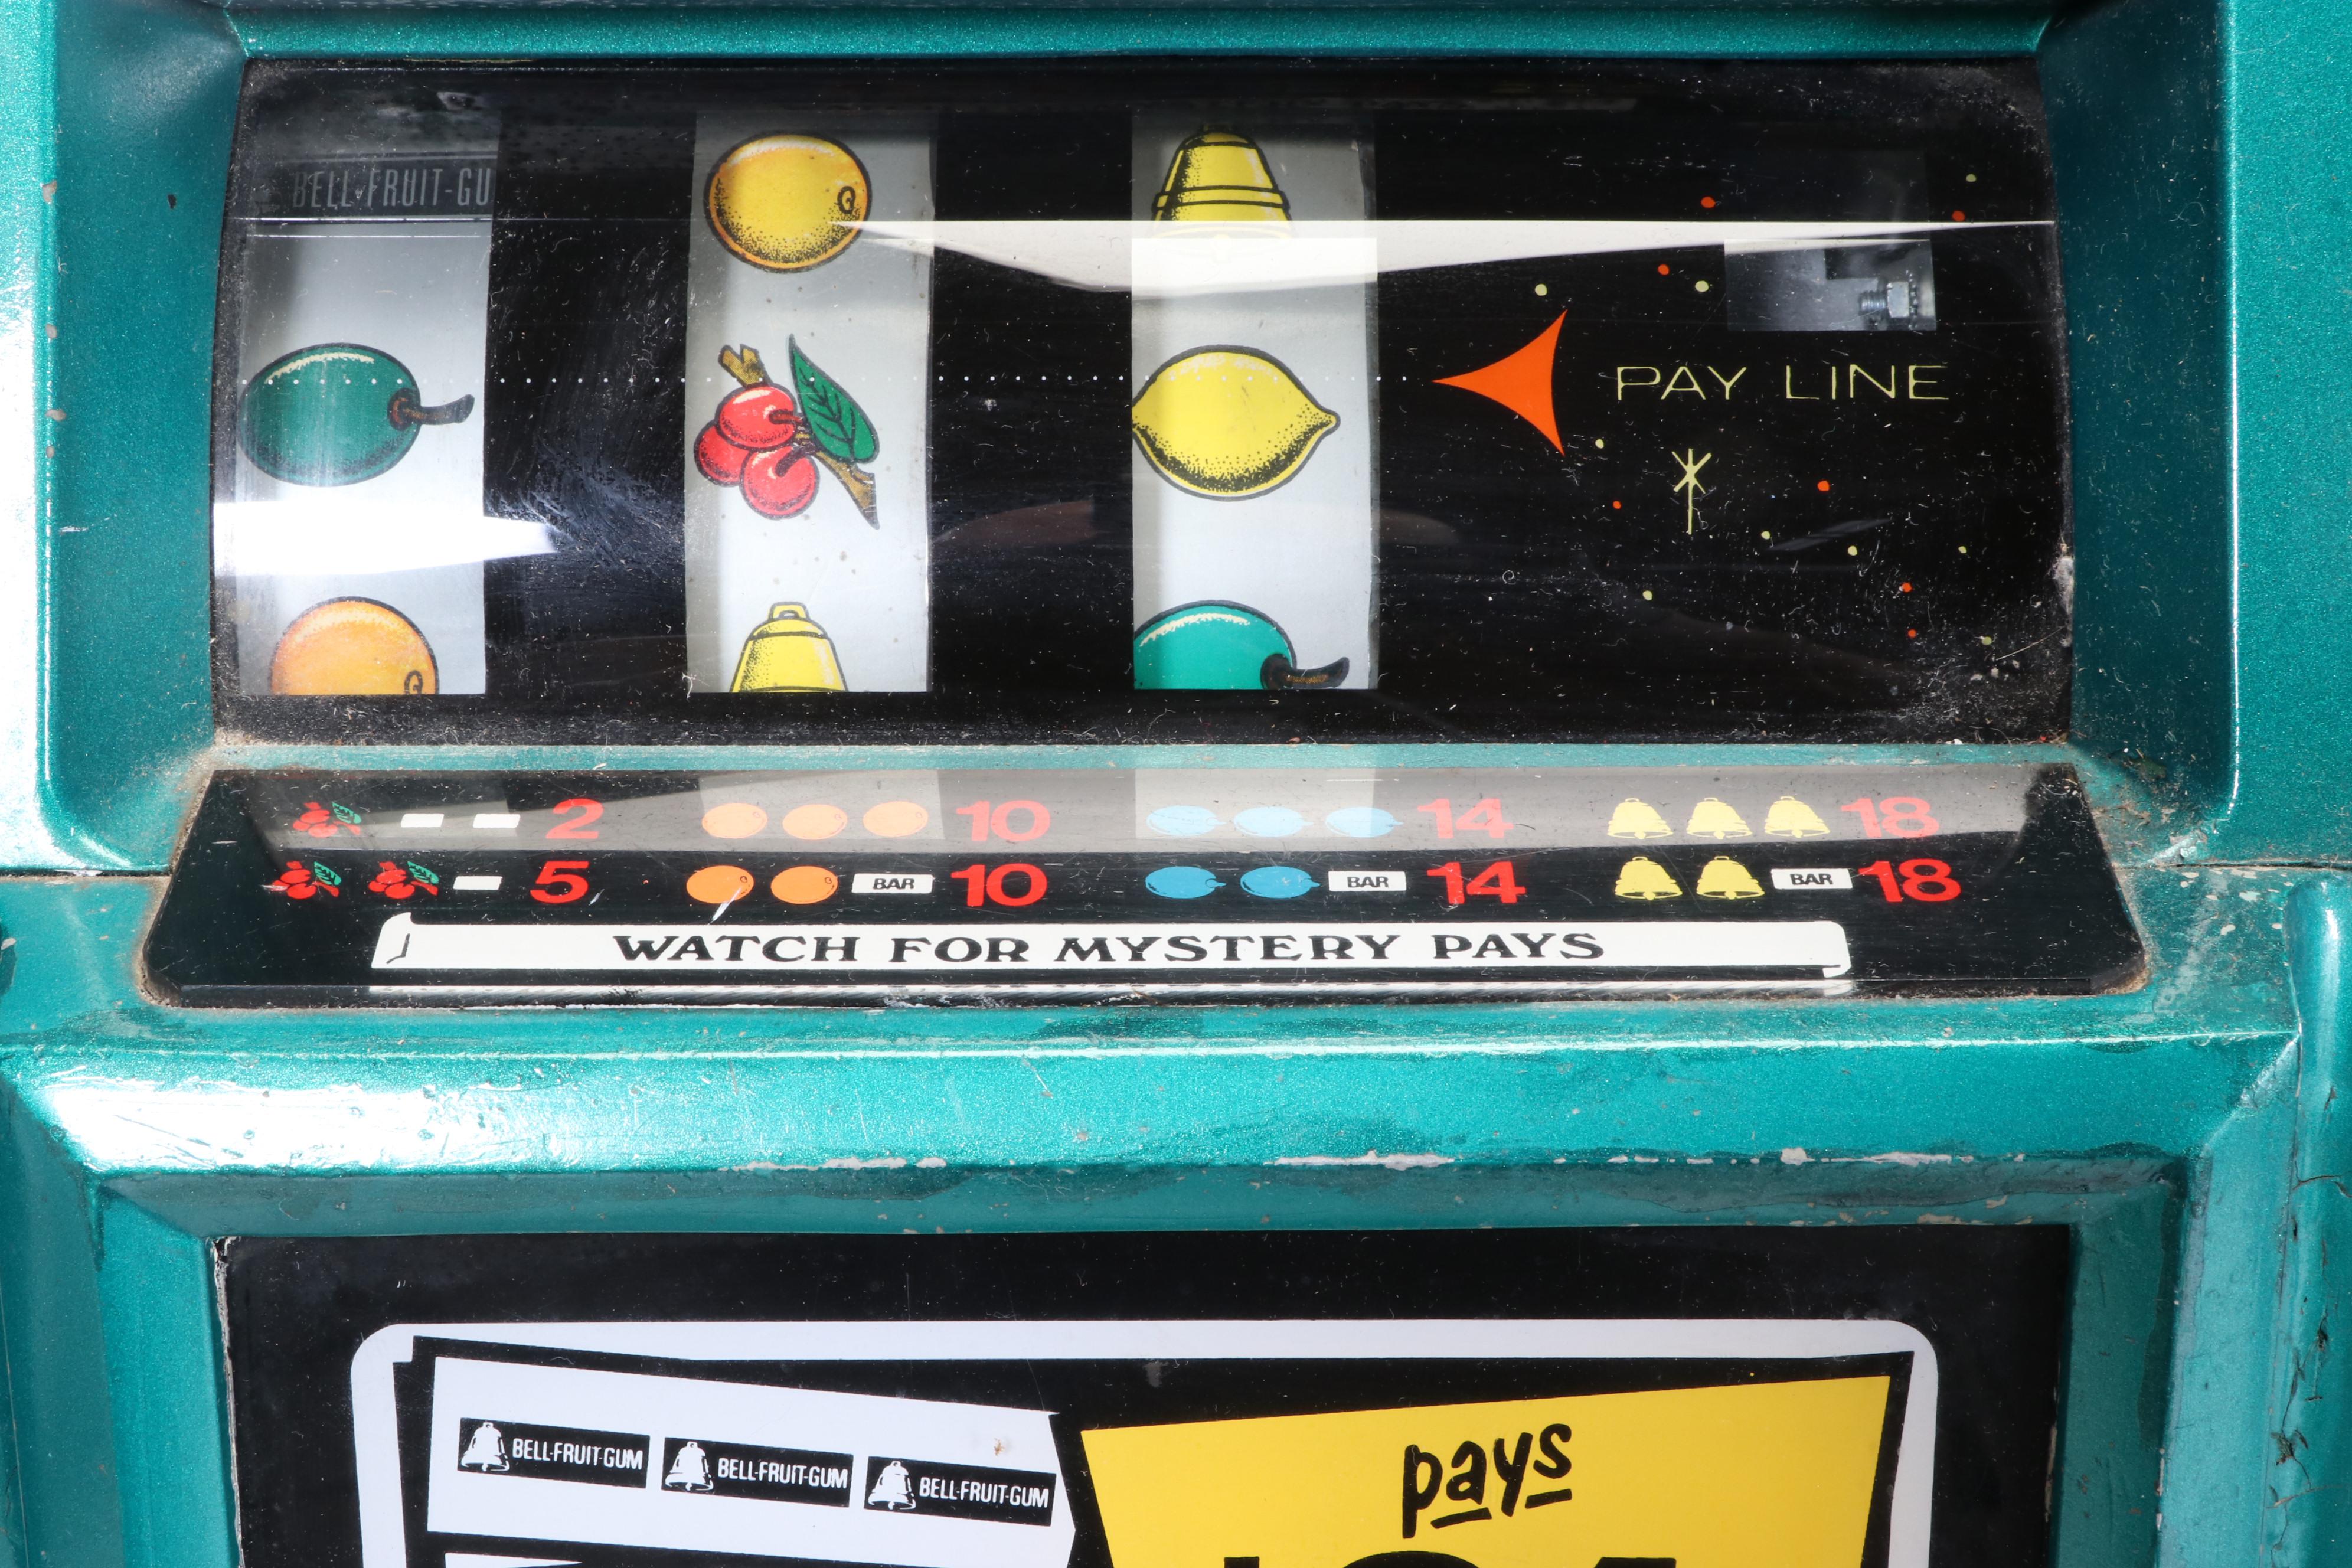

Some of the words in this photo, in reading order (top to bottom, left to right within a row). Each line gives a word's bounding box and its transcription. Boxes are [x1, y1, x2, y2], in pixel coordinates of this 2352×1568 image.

[1616, 365, 1747, 401] PAY
[1785, 364, 1949, 400] LINE
[545, 798, 605, 839] 2
[956, 800, 1051, 841] 10
[1417, 798, 1514, 839] 14
[1841, 796, 1940, 838] 18
[530, 860, 589, 904] 5
[873, 877, 915, 890] BAR
[950, 863, 1048, 907] 10
[1347, 876, 1389, 888] BAR
[1426, 861, 1527, 905] 14
[1789, 873, 1833, 886] BAR
[1858, 858, 1962, 903] 18
[613, 935, 861, 962] WATCH
[888, 937, 1030, 963] FOR
[1054, 935, 1402, 962] MYSTERY
[1432, 933, 1604, 959] PAYS
[512, 1438, 643, 1471] BELL-FRUIT-GUM
[717, 1457, 848, 1489] BELL-FRUIT-GUM
[919, 1476, 1050, 1508] BELL-FRUIT-GUM
[1402, 1423, 1573, 1539] pays
